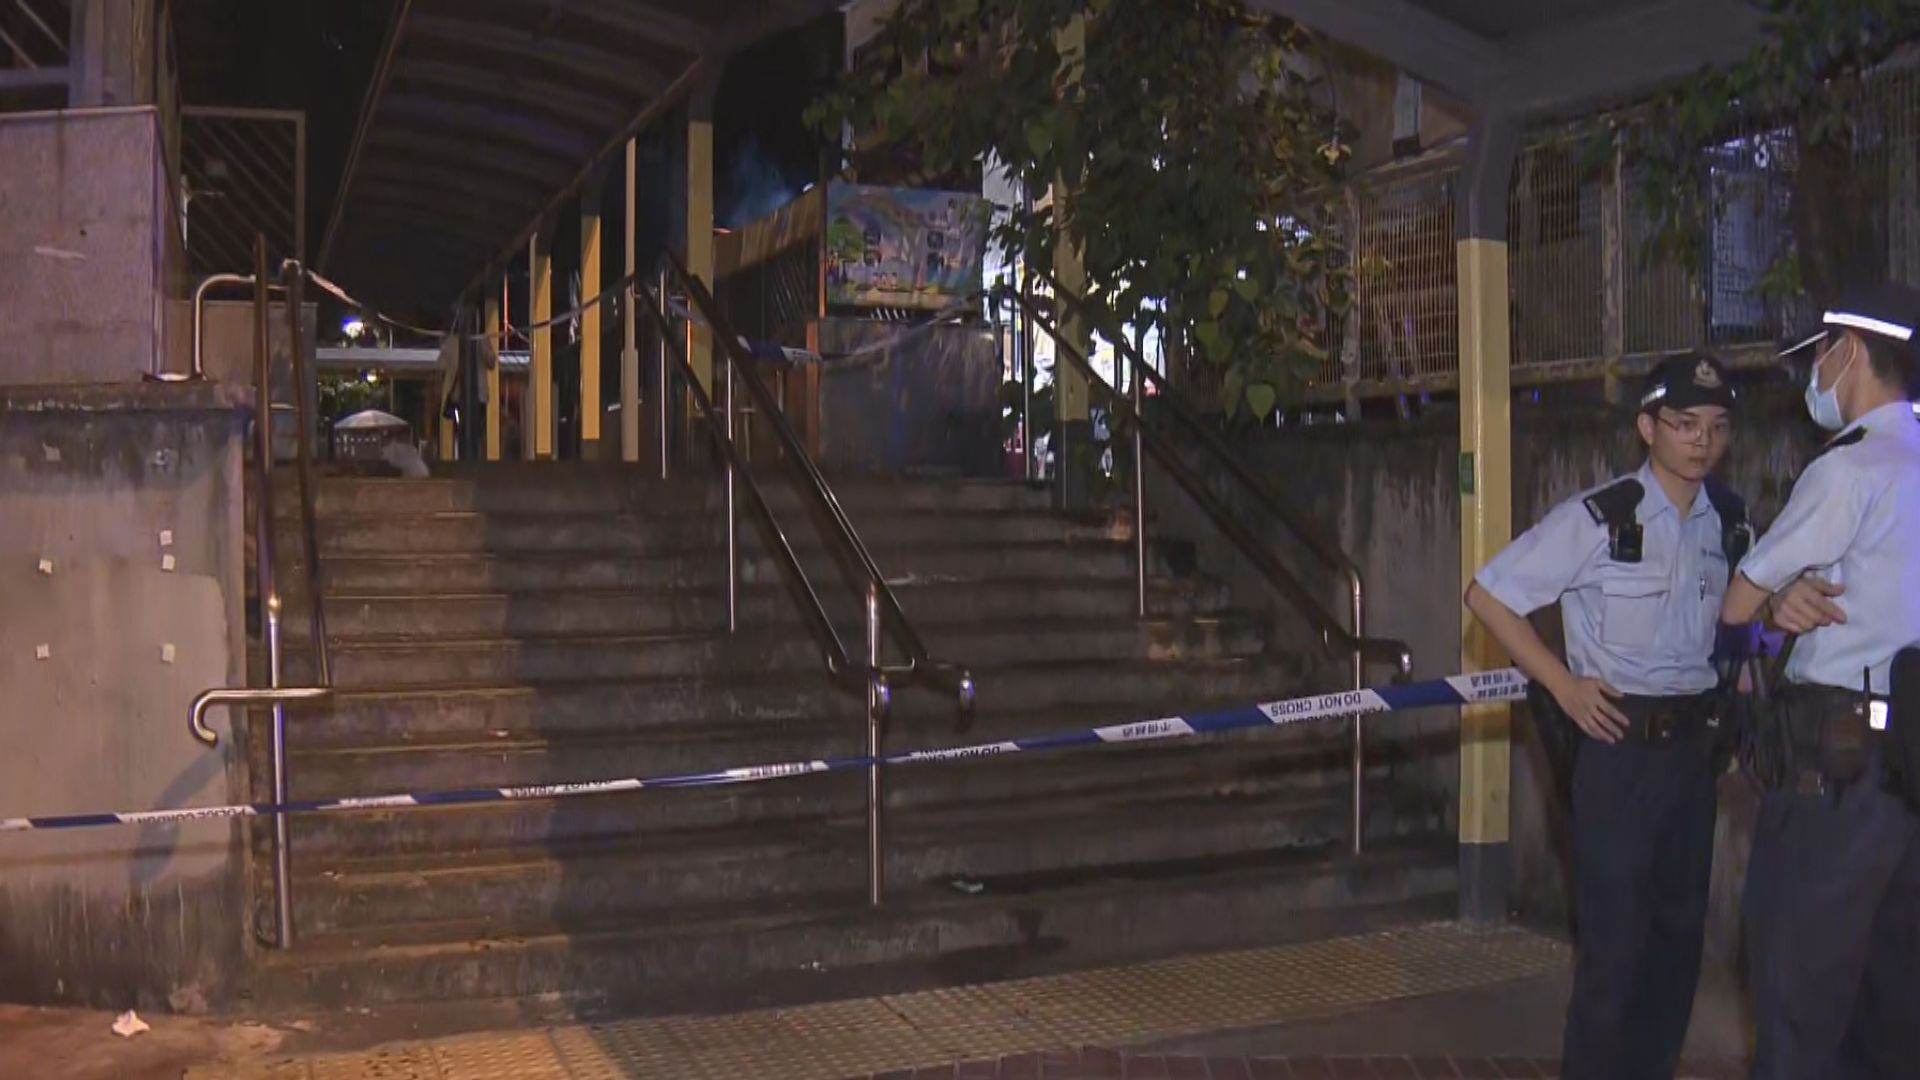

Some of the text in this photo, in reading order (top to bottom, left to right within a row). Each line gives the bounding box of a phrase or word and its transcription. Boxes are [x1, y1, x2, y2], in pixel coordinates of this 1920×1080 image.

[1318, 695, 1342, 710] NOT
[1343, 692, 1361, 706] DO
[1270, 699, 1312, 717] CROSS
